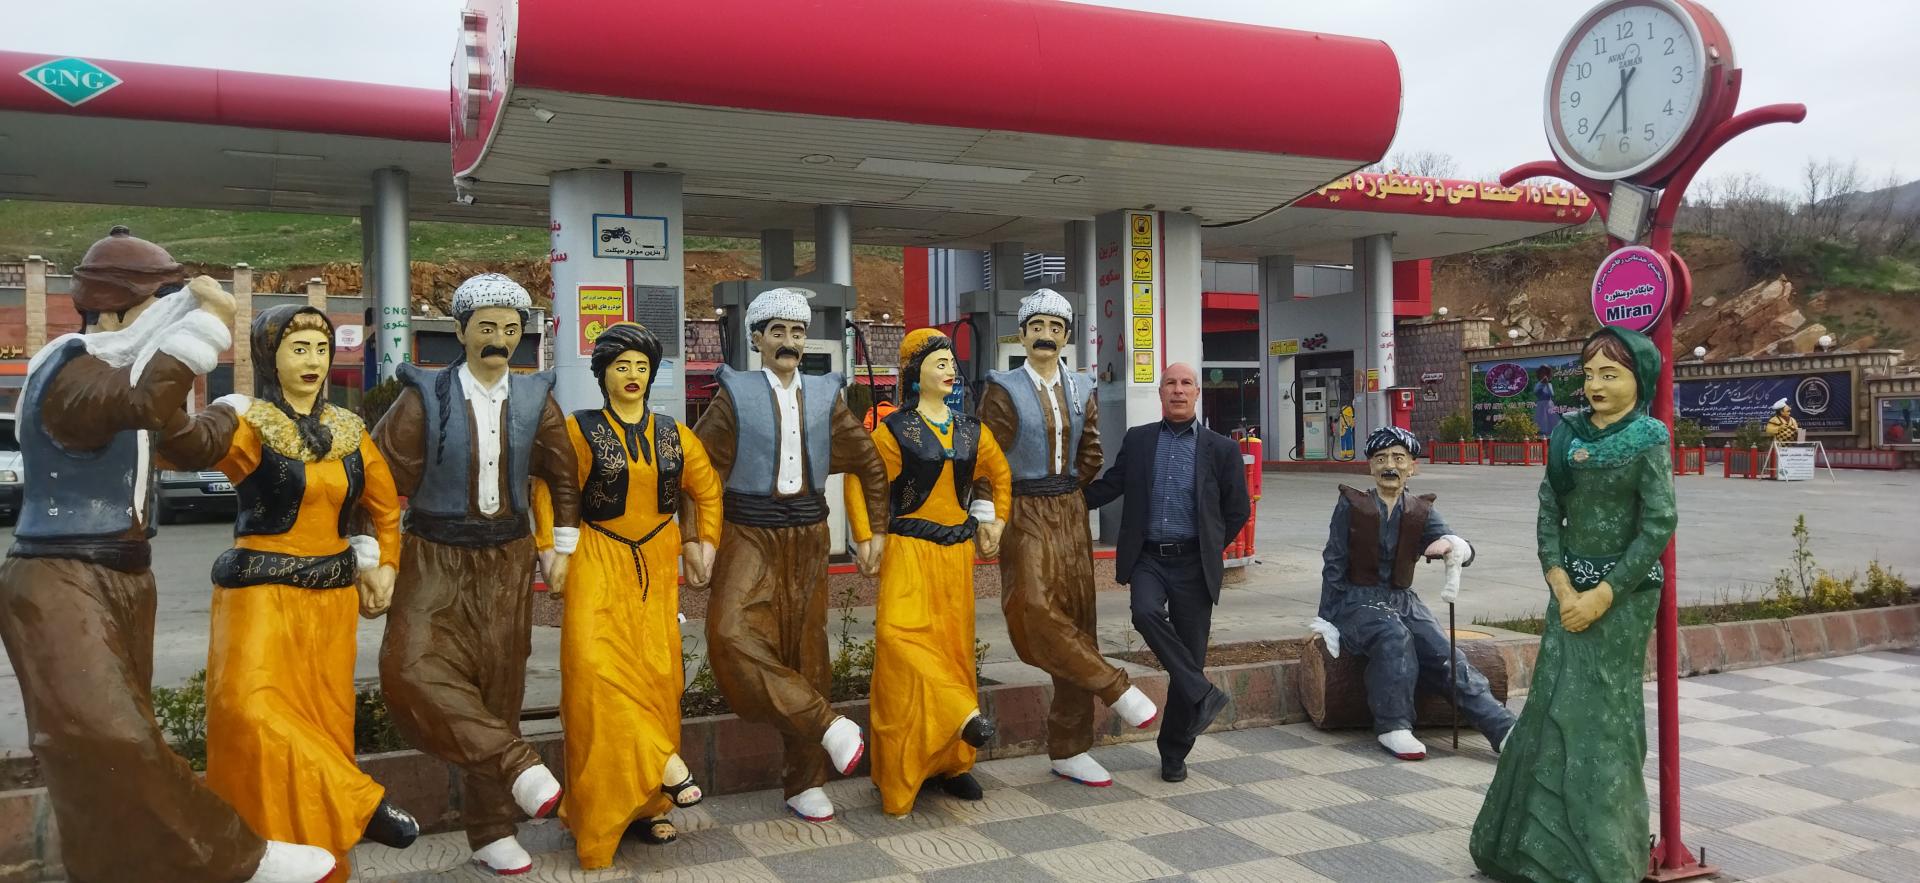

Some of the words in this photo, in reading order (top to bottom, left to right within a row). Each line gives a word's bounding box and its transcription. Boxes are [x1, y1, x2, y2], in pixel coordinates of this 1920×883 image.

[1616, 21, 1634, 41] 12
[1647, 22, 1655, 40] 1
[1594, 37, 1608, 56] 11
[1663, 37, 1675, 56] 2
[1576, 62, 1592, 81] 10
[1618, 56, 1643, 69] ZAMAN
[37, 67, 105, 89] CNG
[1671, 66, 1684, 84] 3
[1570, 91, 1581, 108] 9
[1662, 99, 1674, 116] 4
[1577, 118, 1589, 135] 8
[1643, 123, 1655, 141] 5
[1595, 134, 1607, 151] 7
[1618, 136, 1630, 154] 6
[1449, 181, 1530, 204] اختصاصی
[1099, 241, 1119, 260] بنزین
[1098, 270, 1120, 288] سکوی
[1634, 284, 1655, 296] جایگاه
[384, 307, 408, 315] CNG
[1104, 300, 1113, 318] C
[1606, 304, 1653, 322] Miran
[384, 321, 411, 330] سکوی
[393, 337, 402, 349] ۳
[384, 353, 393, 363] A
[403, 353, 412, 362] B
